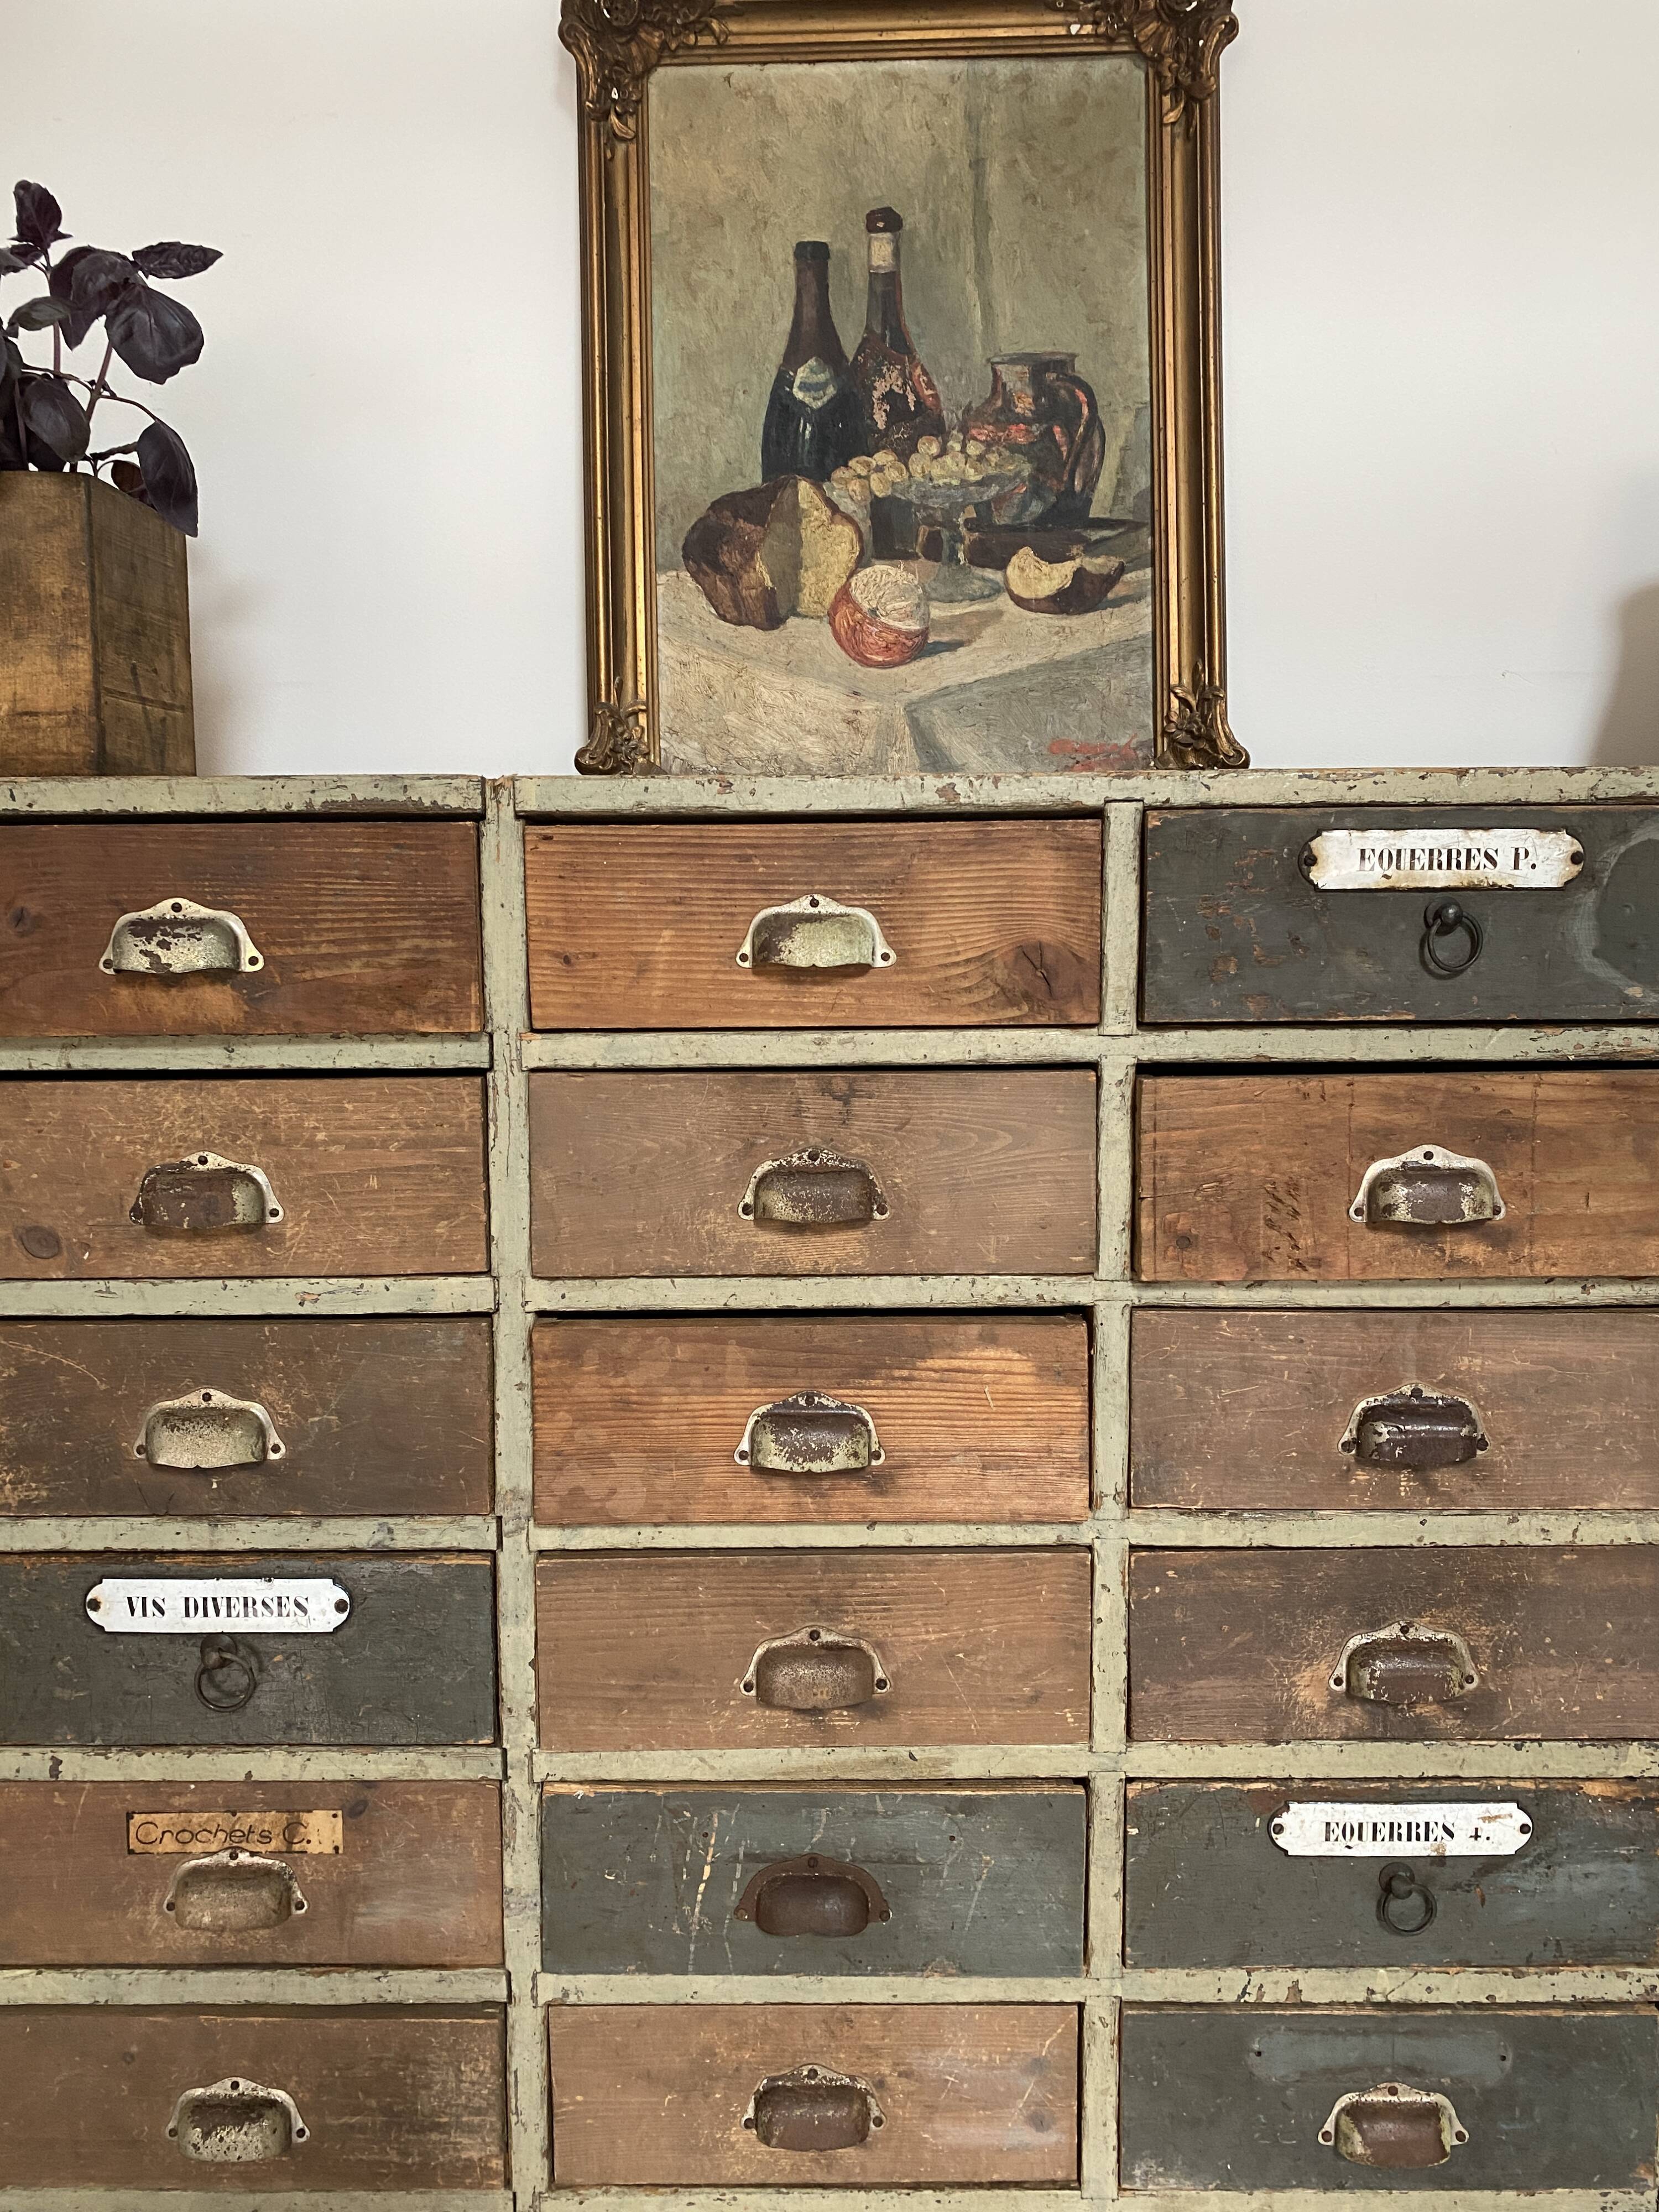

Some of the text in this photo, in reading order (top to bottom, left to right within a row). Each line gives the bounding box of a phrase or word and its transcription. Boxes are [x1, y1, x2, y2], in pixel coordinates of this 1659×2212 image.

[1357, 847, 1537, 880] EQUERRES P.
[127, 1597, 309, 1618] VIS DIVERSES
[136, 1822, 312, 1845] Crochets C.
[1324, 1821, 1455, 1849] EQUERRES
